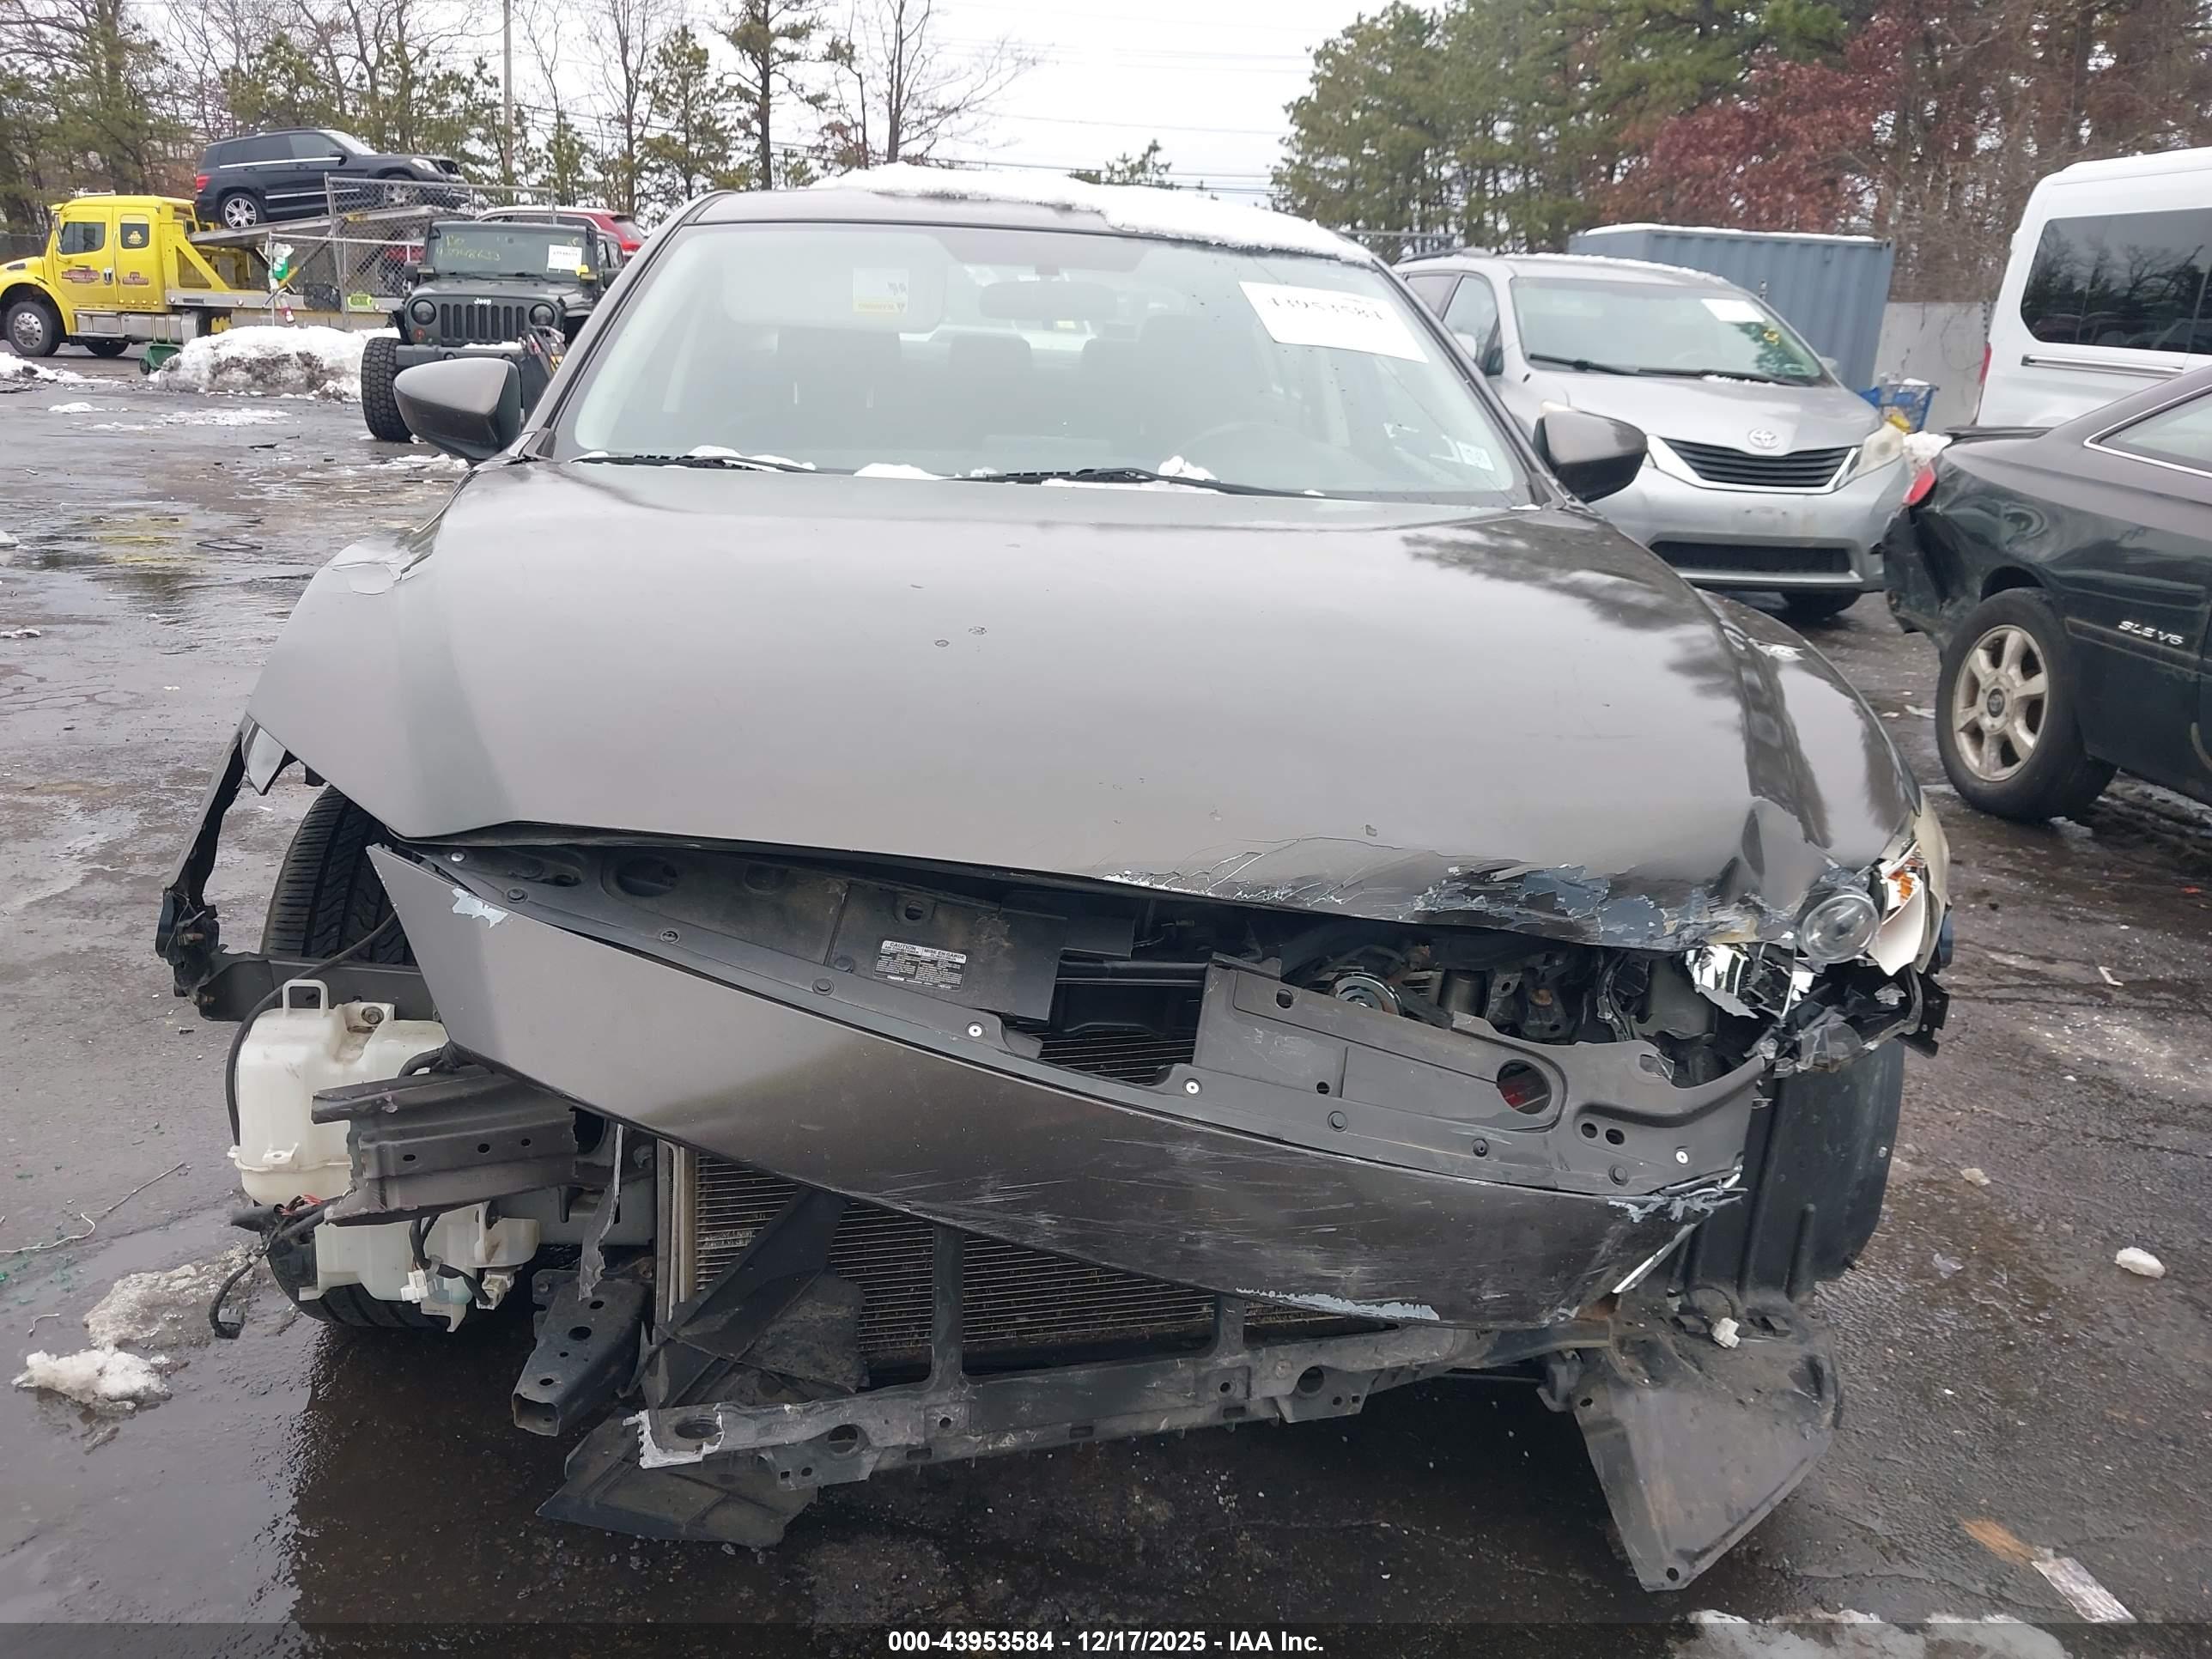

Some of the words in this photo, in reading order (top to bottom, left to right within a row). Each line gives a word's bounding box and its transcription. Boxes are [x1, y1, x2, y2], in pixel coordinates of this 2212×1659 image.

[473, 297, 492, 306] Jeep
[2118, 621, 2157, 638] SLE
[2157, 630, 2185, 646] V6
[890, 942, 916, 951] CAUTION
